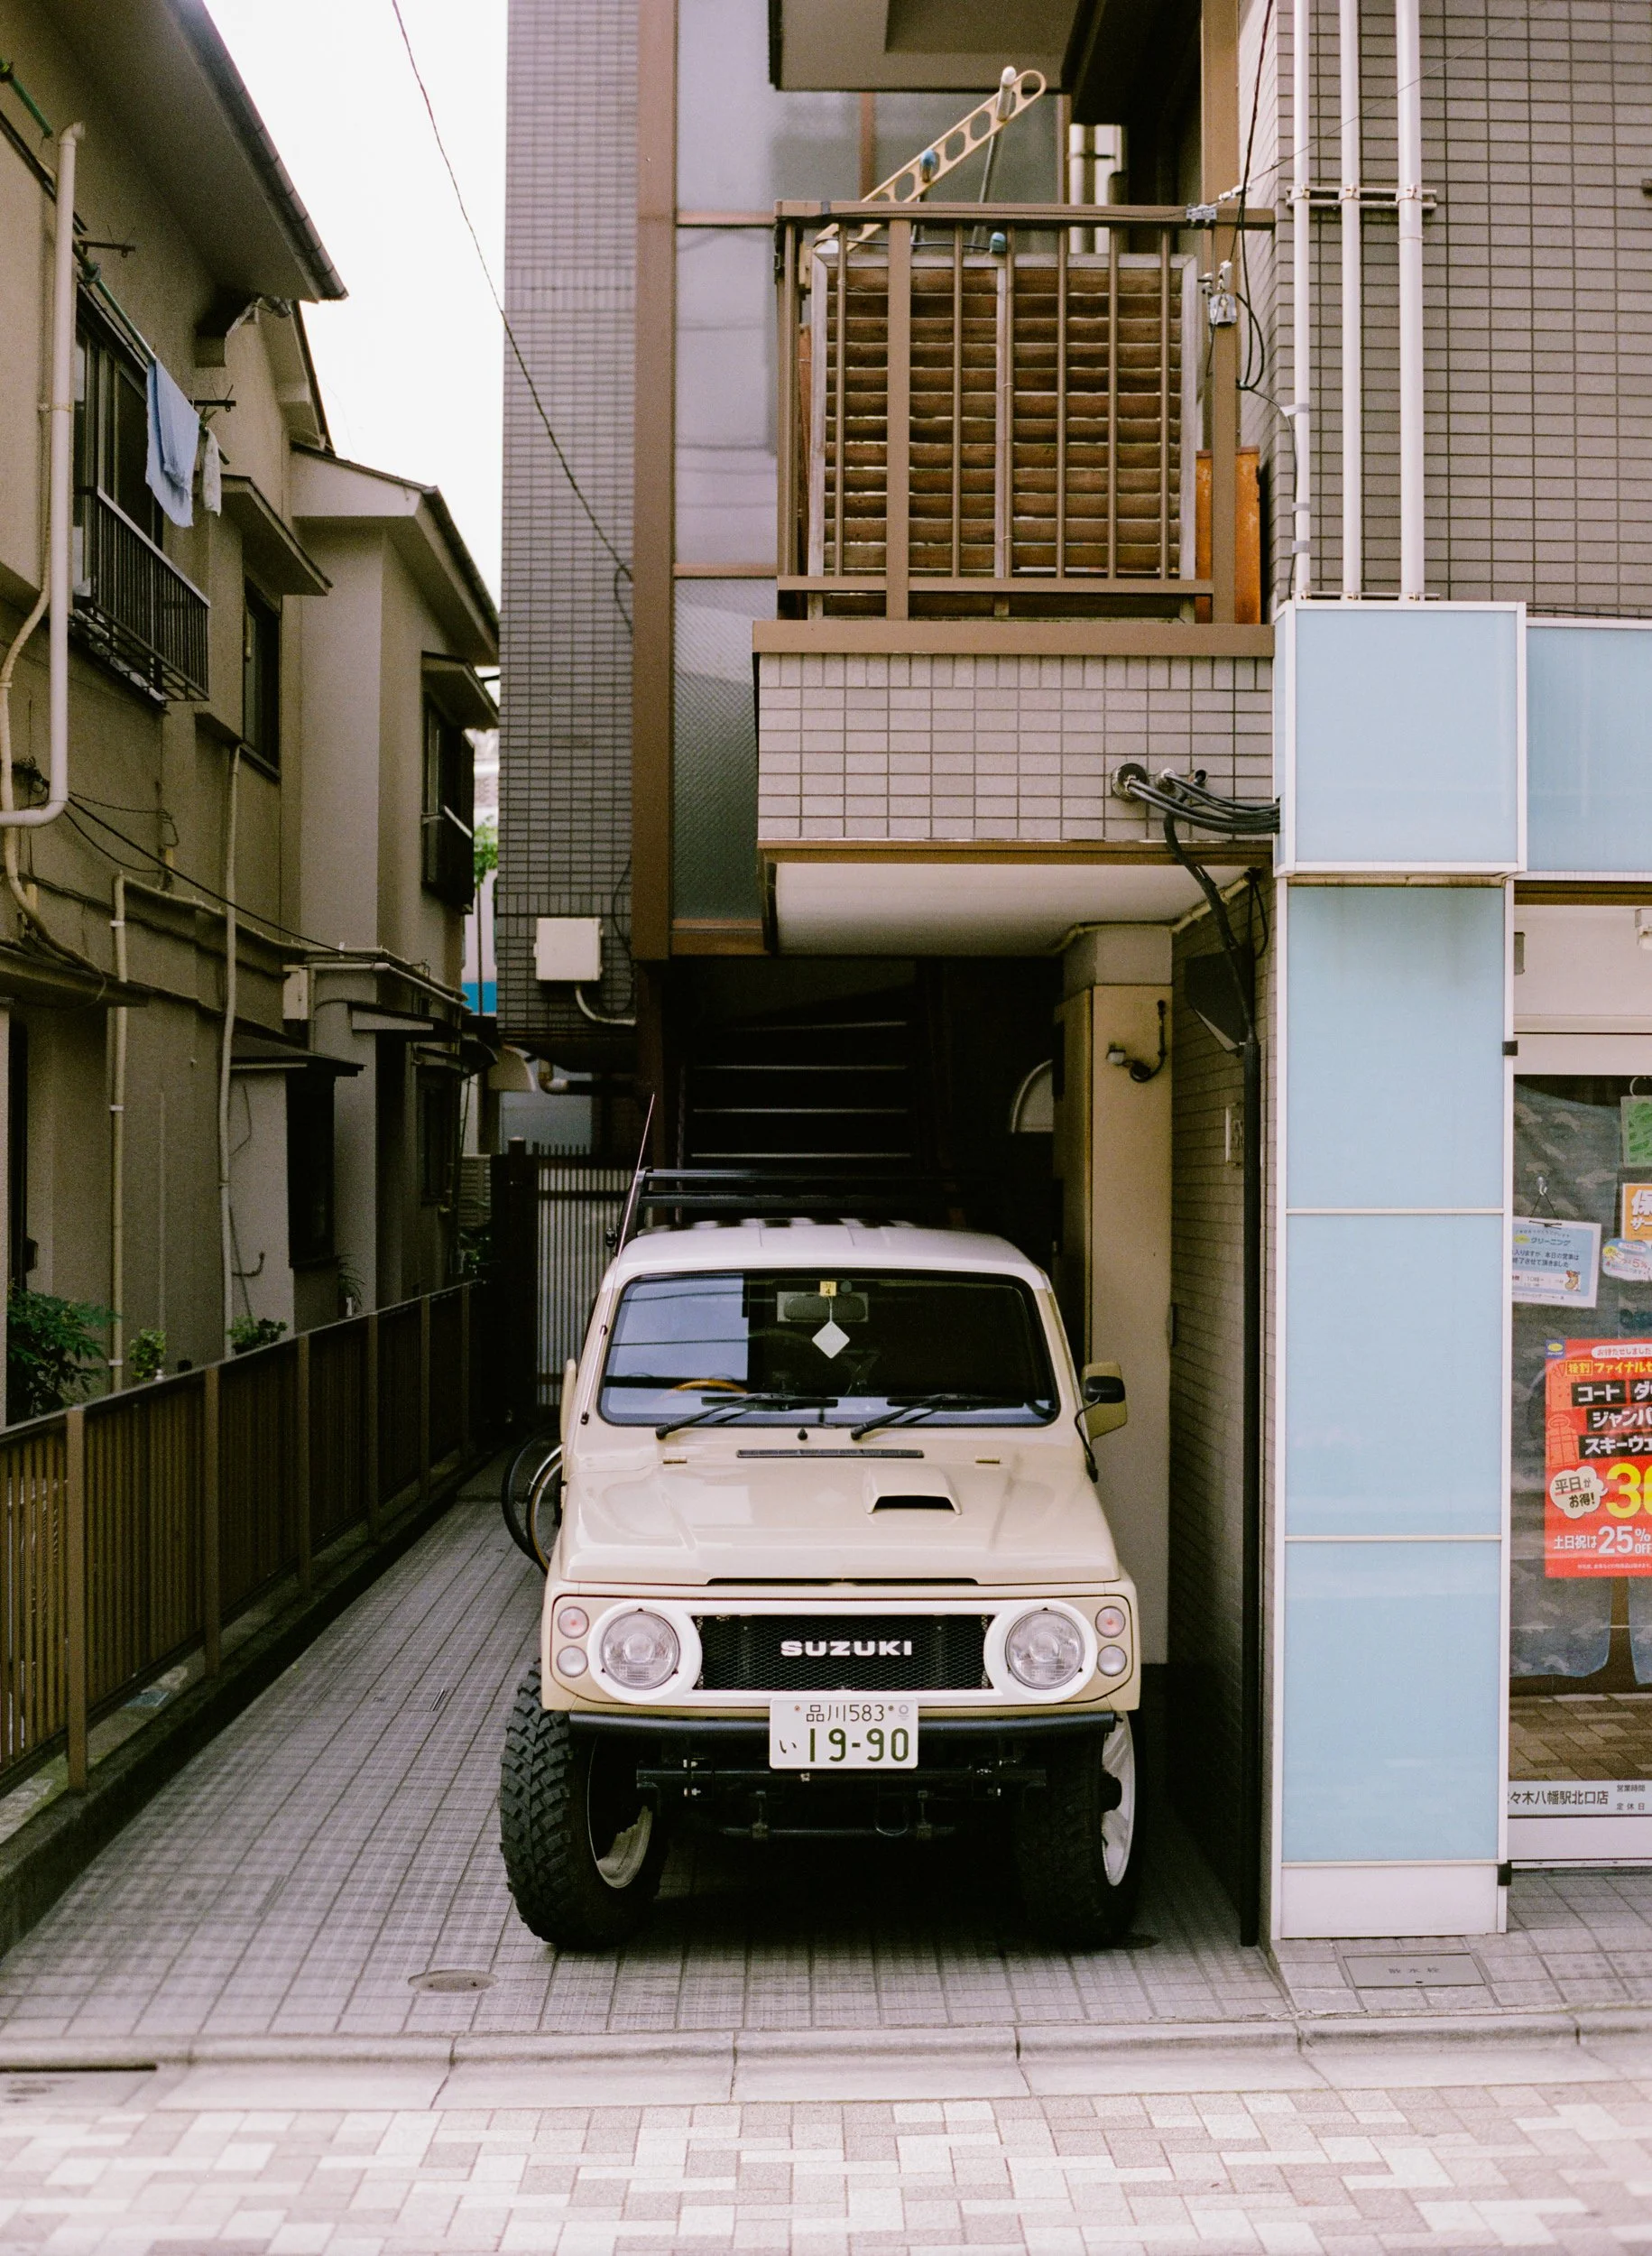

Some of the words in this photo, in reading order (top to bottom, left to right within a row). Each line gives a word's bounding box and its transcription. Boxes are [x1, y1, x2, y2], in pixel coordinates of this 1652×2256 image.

[1530, 1236, 1571, 1246] クリーニング
[1577, 1384, 1620, 1402] コート
[1634, 1381, 1652, 1401] ダ
[1605, 1463, 1652, 1519] 3
[1553, 1535, 1597, 1549] 土日祝は
[1598, 1525, 1633, 1554] 25
[780, 1641, 912, 1656] SUZUKI
[779, 1738, 797, 1753] い
[809, 1728, 909, 1761] 19-90
[1616, 1784, 1646, 1792] 営業時間
[1508, 1790, 1609, 1806] 々木八幡駅北口店
